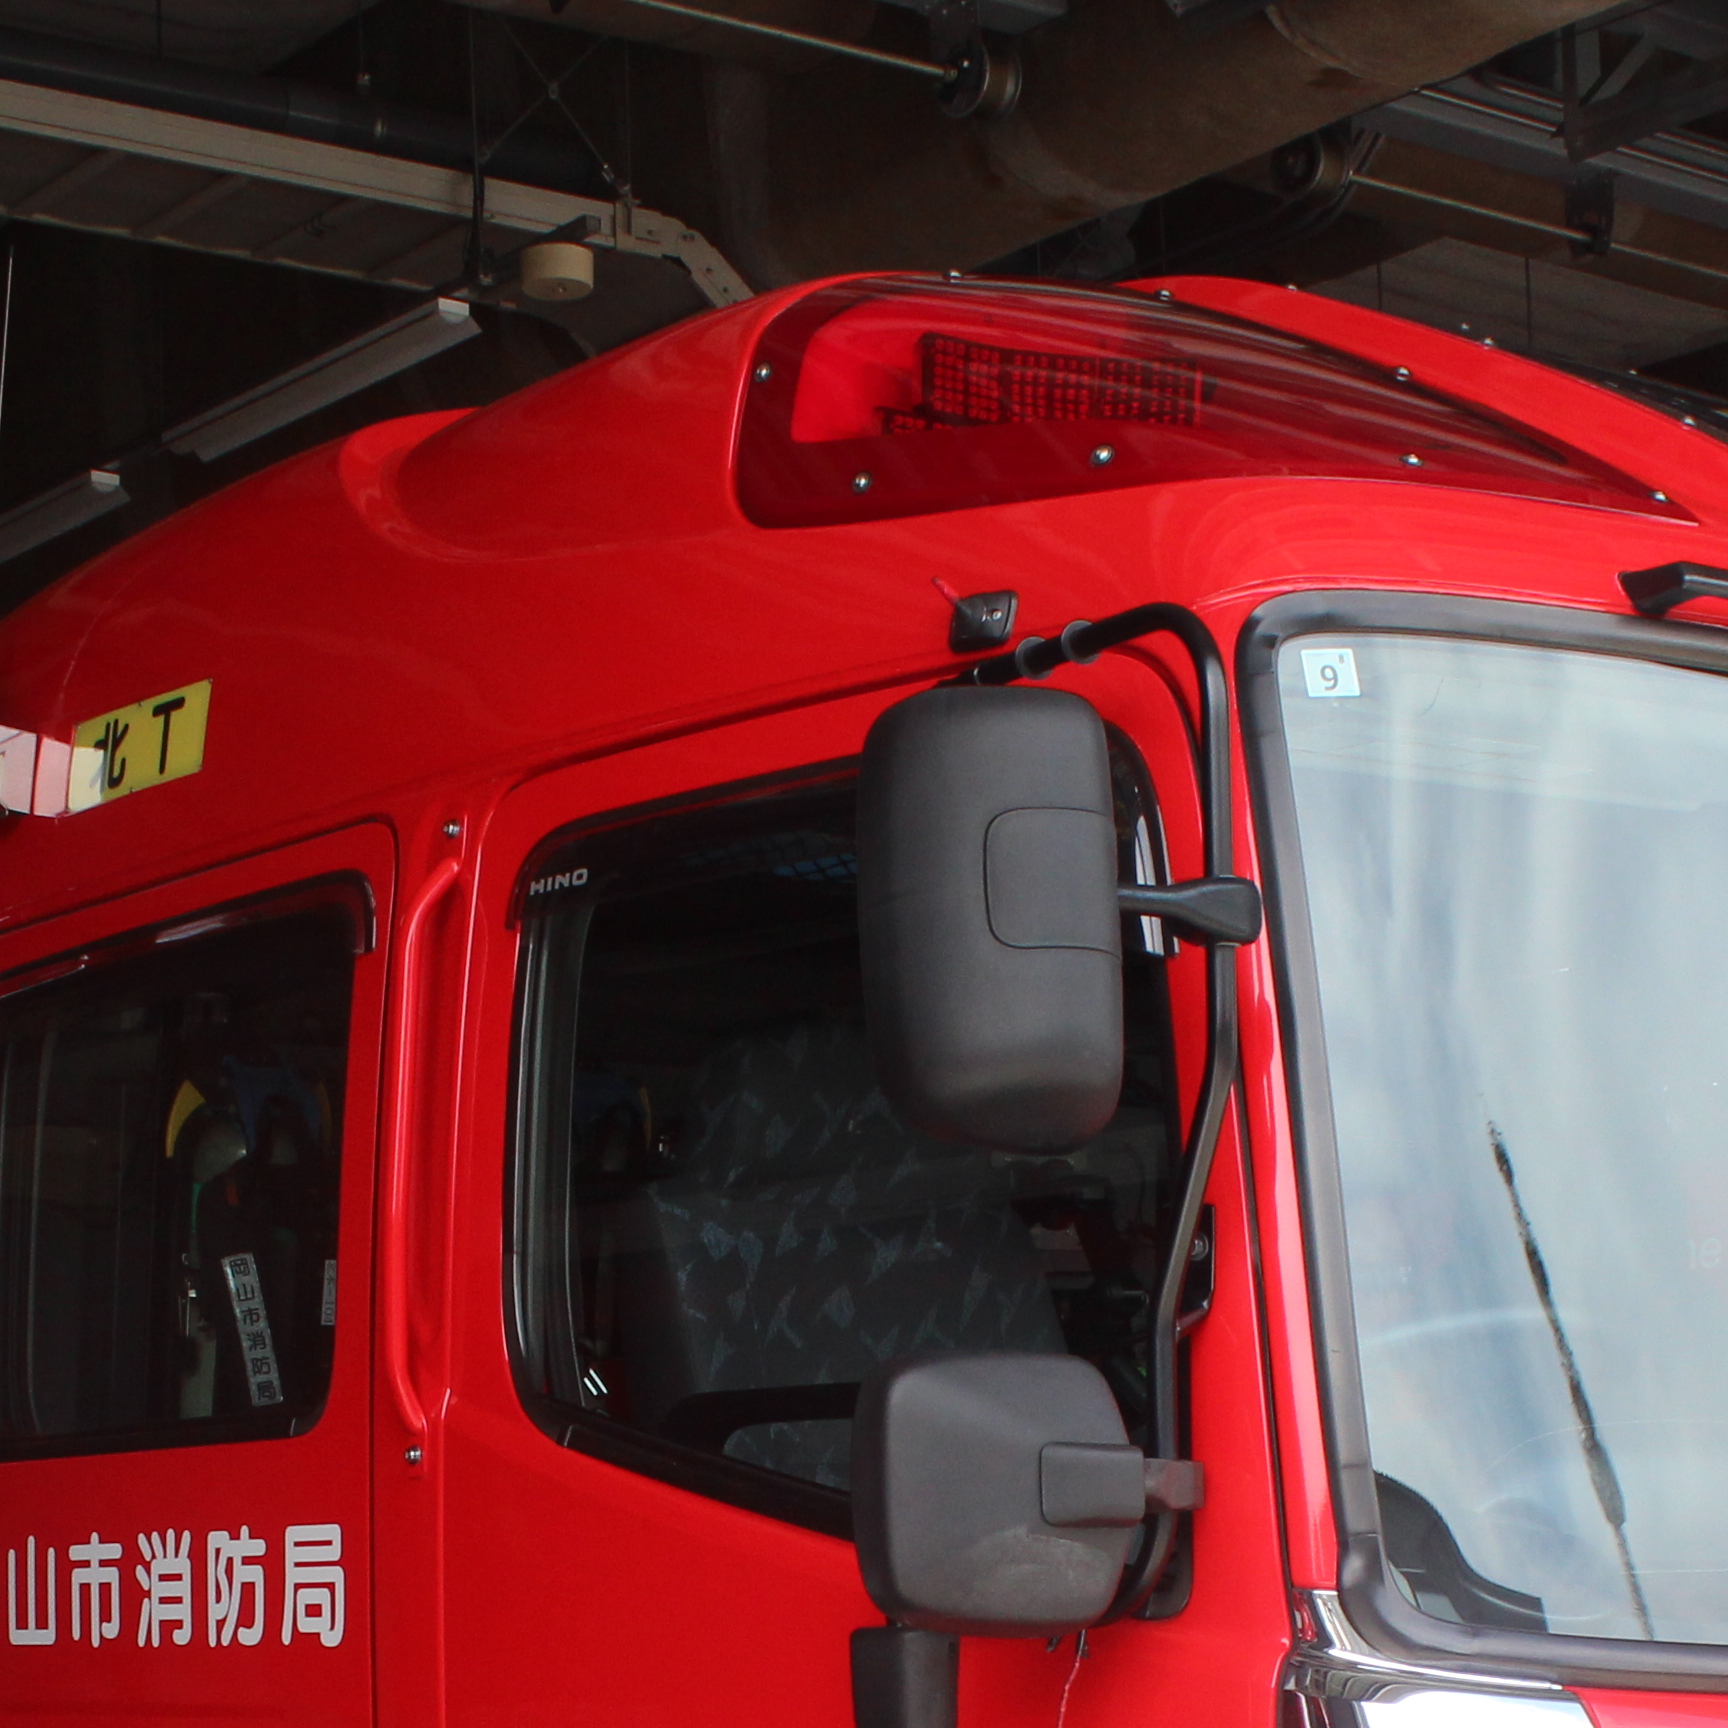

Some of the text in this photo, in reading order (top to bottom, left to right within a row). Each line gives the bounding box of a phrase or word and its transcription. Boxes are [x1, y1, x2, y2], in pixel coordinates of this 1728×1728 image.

[1319, 664, 1340, 692] 9
[152, 696, 186, 774] T
[529, 867, 589, 896] HINO
[228, 1256, 278, 1402] 岡山市消防局
